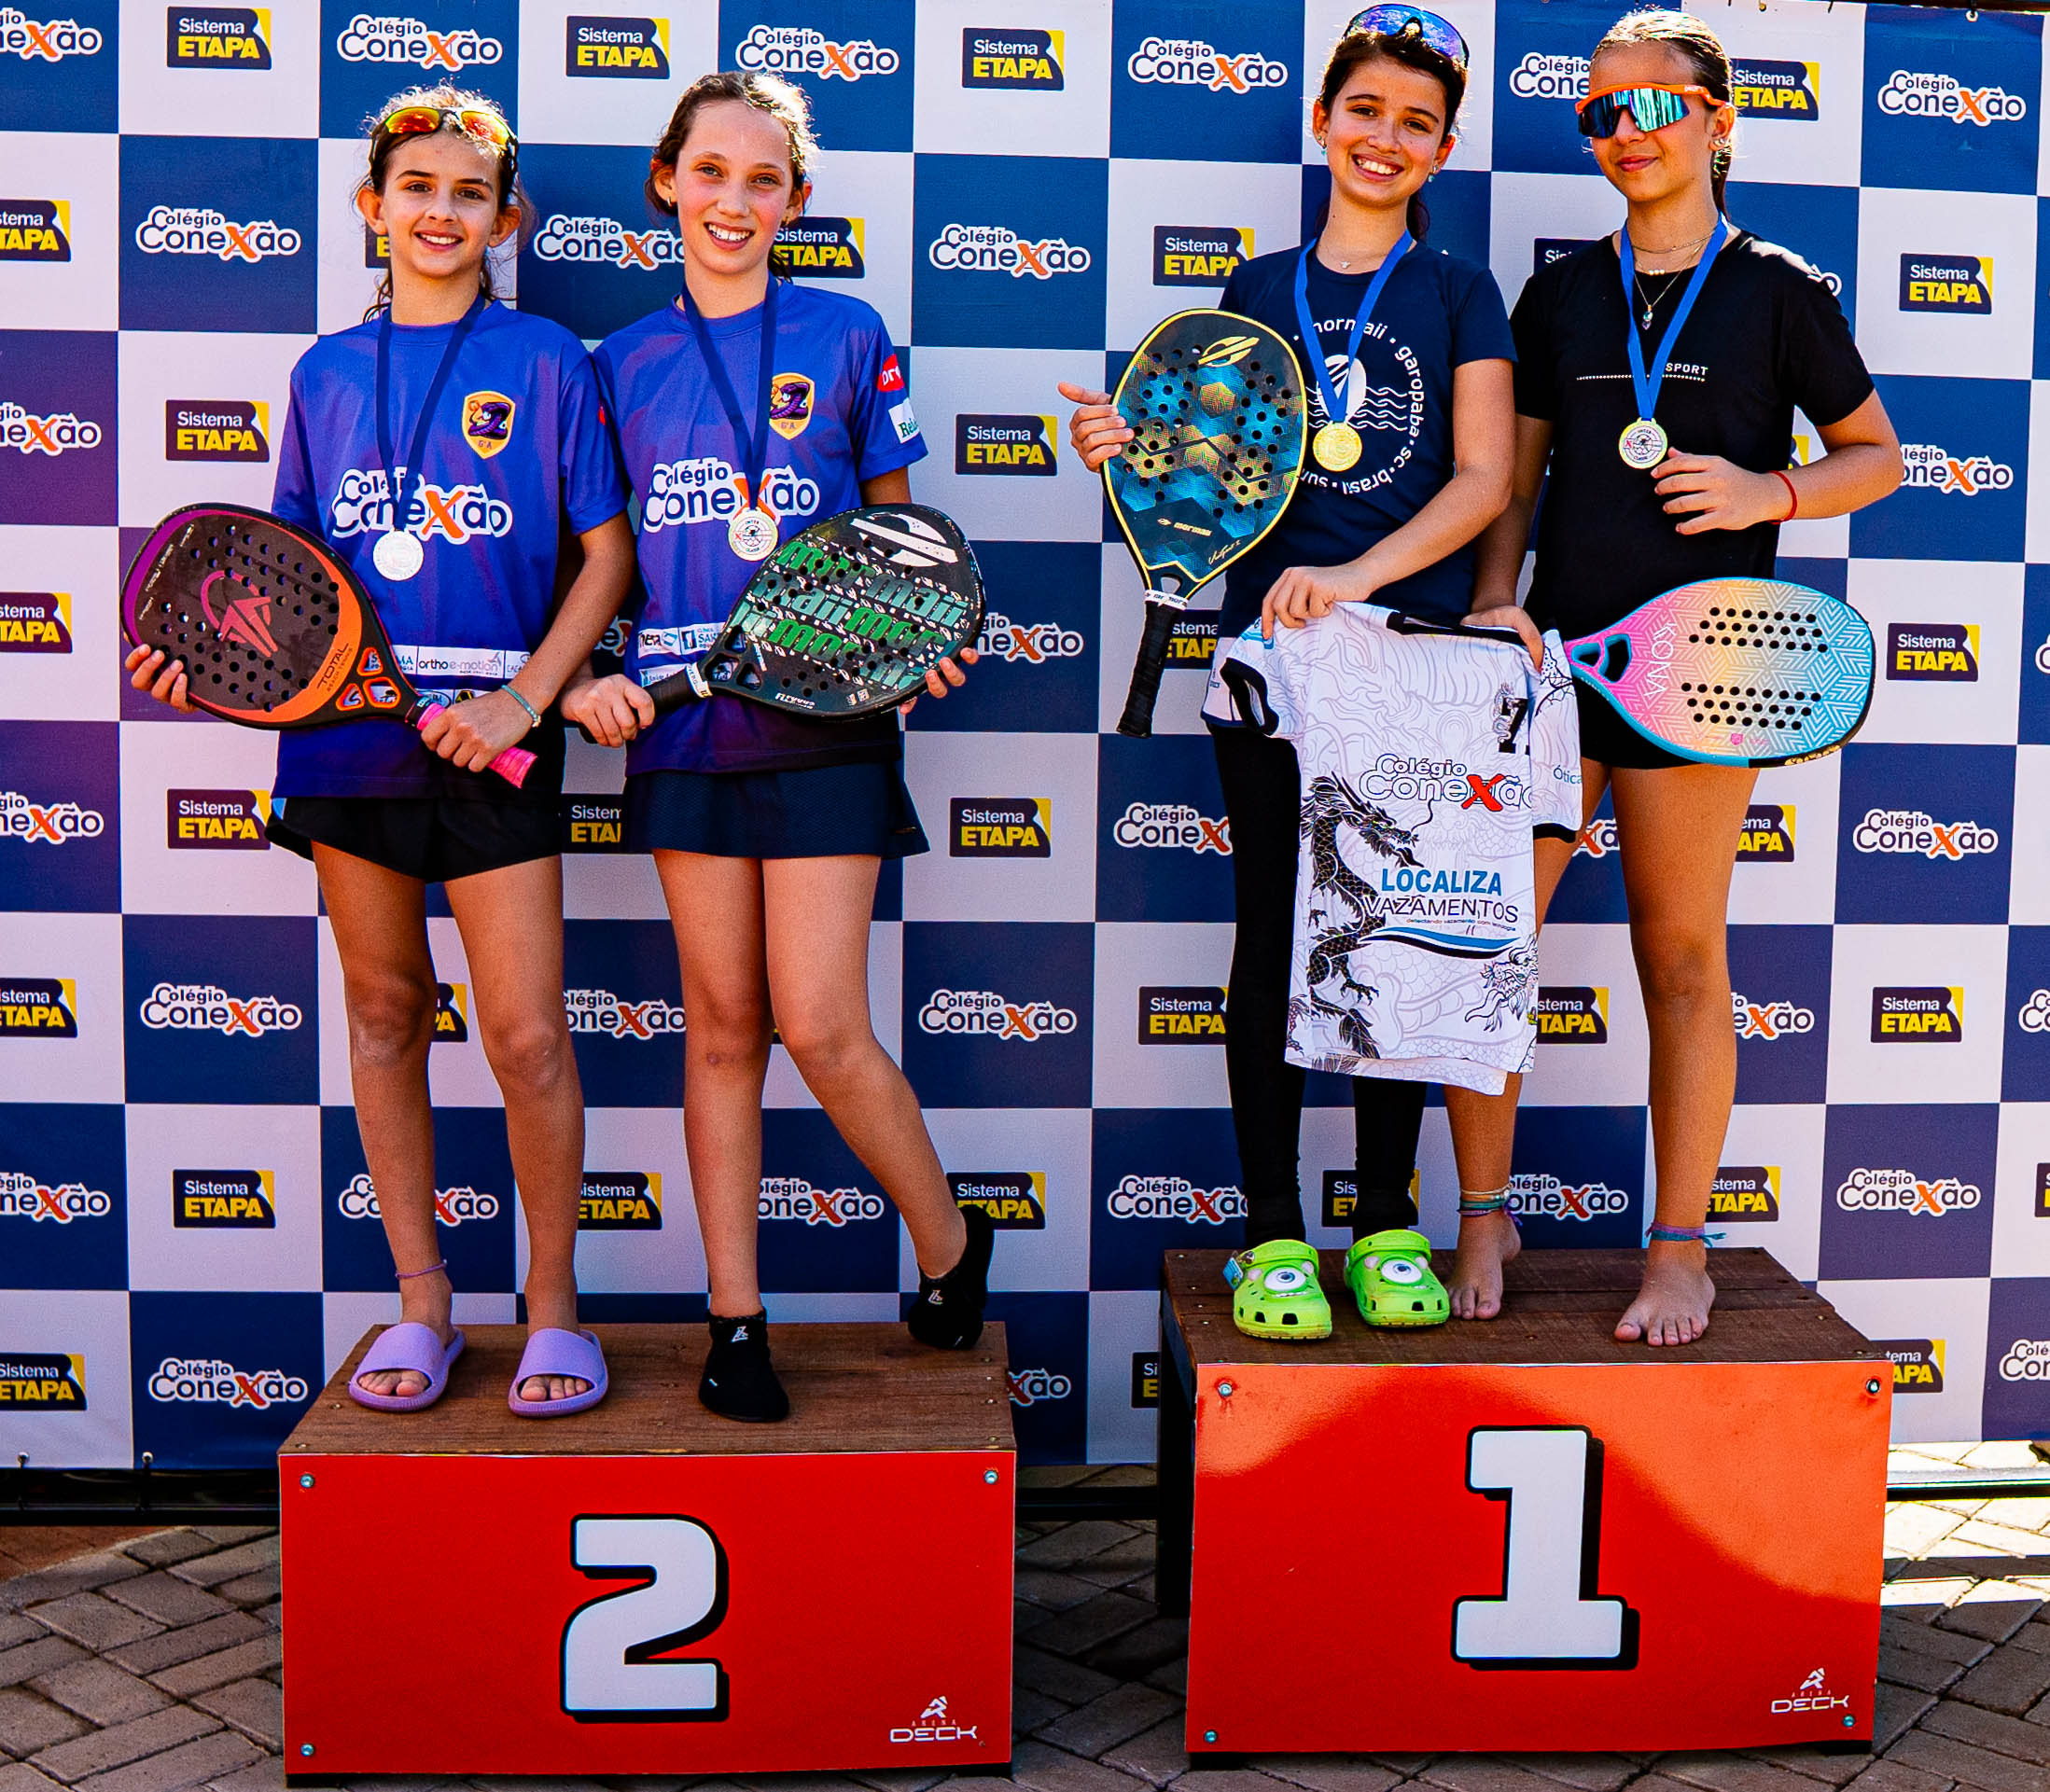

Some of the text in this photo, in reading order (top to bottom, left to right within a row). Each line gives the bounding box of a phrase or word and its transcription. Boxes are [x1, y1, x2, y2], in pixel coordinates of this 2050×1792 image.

[179, 18, 244, 35] Sistema
[354, 17, 424, 37] Colégio
[578, 28, 643, 44] Sistema
[0, 22, 100, 57] eXão
[178, 35, 260, 59] ETAPA
[752, 28, 820, 47] Colégio
[974, 39, 1038, 55] Sistema
[578, 45, 658, 68] ETAPA
[1145, 40, 1210, 61] Colégio
[973, 57, 1053, 79] ETAPA
[1526, 55, 1589, 74] Colégio
[1513, 72, 1589, 96] Cone
[1735, 69, 1794, 86] Sistema
[1894, 74, 1955, 91] Colégio
[1734, 87, 1807, 110] ETAPA
[154, 209, 221, 229] Colégio
[552, 217, 617, 236] Colégio
[0, 229, 59, 250] TAPA
[775, 228, 838, 243] Sistema
[945, 227, 1012, 246] Colégio
[1165, 237, 1228, 254] Sistema
[774, 246, 853, 268] ETAPA
[1911, 265, 1968, 280] Sistema
[1909, 282, 1982, 305] ETAPA
[1665, 362, 1708, 375] SPORT
[1394, 345, 1425, 438] garopaba
[177, 411, 243, 427] Sistema
[0, 416, 99, 451] eXão
[176, 429, 258, 451] ETAPA
[968, 426, 1030, 441] Sistema
[967, 444, 1045, 465] ETAPA
[1393, 446, 1412, 468] sc
[1904, 448, 1944, 464] légio
[653, 464, 728, 493] Colégio
[1342, 467, 1393, 495] brasil
[0, 604, 45, 618] stema
[0, 621, 61, 642] TAPA
[1173, 621, 1218, 635] stema
[978, 626, 1081, 660] neXão
[1898, 633, 1956, 648] Sistema
[316, 643, 349, 689] TOTAL
[418, 660, 449, 670] ortho
[1643, 622, 1678, 697] KONA
[1897, 651, 1969, 672] ETAPA
[1375, 754, 1467, 778] Colégio
[179, 800, 243, 815] Sistema
[962, 809, 1025, 824] Sistema
[1129, 805, 1195, 824] Colégio
[0, 806, 101, 840] neXão
[178, 817, 259, 840] ETAPA
[1868, 812, 1929, 830] Colégio
[571, 823, 621, 842] ETA
[961, 827, 1039, 847] ETAPA
[1116, 820, 1231, 852] ConeX
[1736, 831, 1784, 852] APA
[1382, 868, 1502, 896] LOCALIZA
[1362, 894, 1519, 923] VAZAMENTOS
[0, 990, 49, 1004] stema
[156, 986, 223, 1006] Colégio
[565, 991, 614, 1007] légio
[934, 993, 1000, 1011] Colégio
[1151, 997, 1212, 1012] Sistema
[1538, 999, 1583, 1011] stema
[1882, 997, 1940, 1011] Sistema
[0, 1007, 66, 1027] TAPA
[566, 1005, 685, 1036] oneXão
[1150, 1015, 1226, 1035] ETAPA
[1538, 1014, 1597, 1034] TAPA
[1733, 1006, 1812, 1037] eXão
[1881, 1013, 1952, 1034] ETAPA
[185, 1180, 248, 1195] Sistema
[759, 1180, 807, 1195] légio
[1122, 1177, 1188, 1196] Colégio
[1712, 1178, 1756, 1191] stema
[1852, 1172, 1911, 1188] Colégio
[580, 1184, 635, 1197] istema
[957, 1183, 1019, 1198] Sistema
[0, 1188, 108, 1220] neXão
[184, 1198, 264, 1218] ETAPA
[758, 1191, 884, 1224] oneXão
[1508, 1187, 1625, 1218] oneXão
[1885, 1351, 1922, 1363] tema
[2014, 1341, 2050, 1358] Colé
[162, 1360, 230, 1379] Colégio
[1892, 1365, 1933, 1384] APA
[1454, 1426, 1635, 1666] 1
[562, 1514, 725, 1717] 2
[1771, 1695, 1848, 1713] DECK
[889, 1725, 978, 1743] DECK
